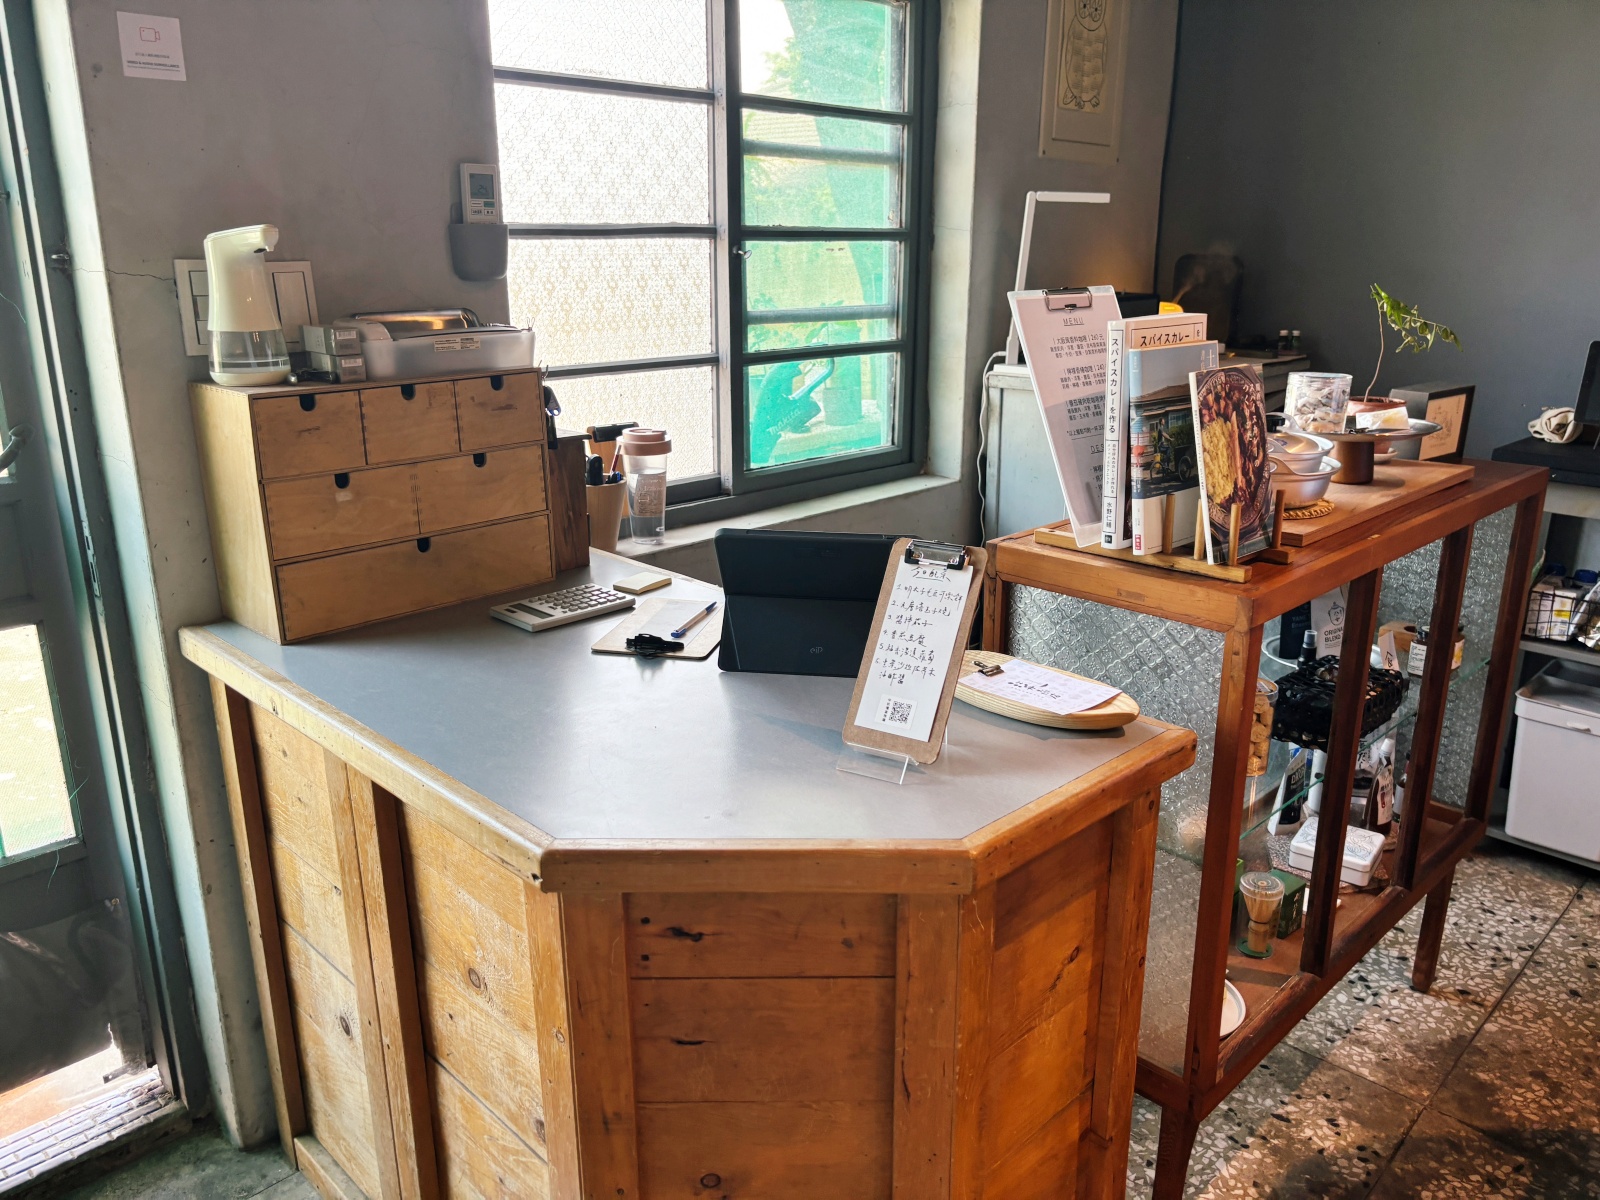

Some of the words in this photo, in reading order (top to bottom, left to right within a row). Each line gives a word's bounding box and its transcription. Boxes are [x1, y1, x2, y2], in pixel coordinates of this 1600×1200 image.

[1063, 317, 1084, 325] MENU
[1140, 332, 1190, 347] スパイスカレー
[1108, 338, 1120, 434] スパイスカレーを作る
[911, 566, 951, 582] 今日配菜
